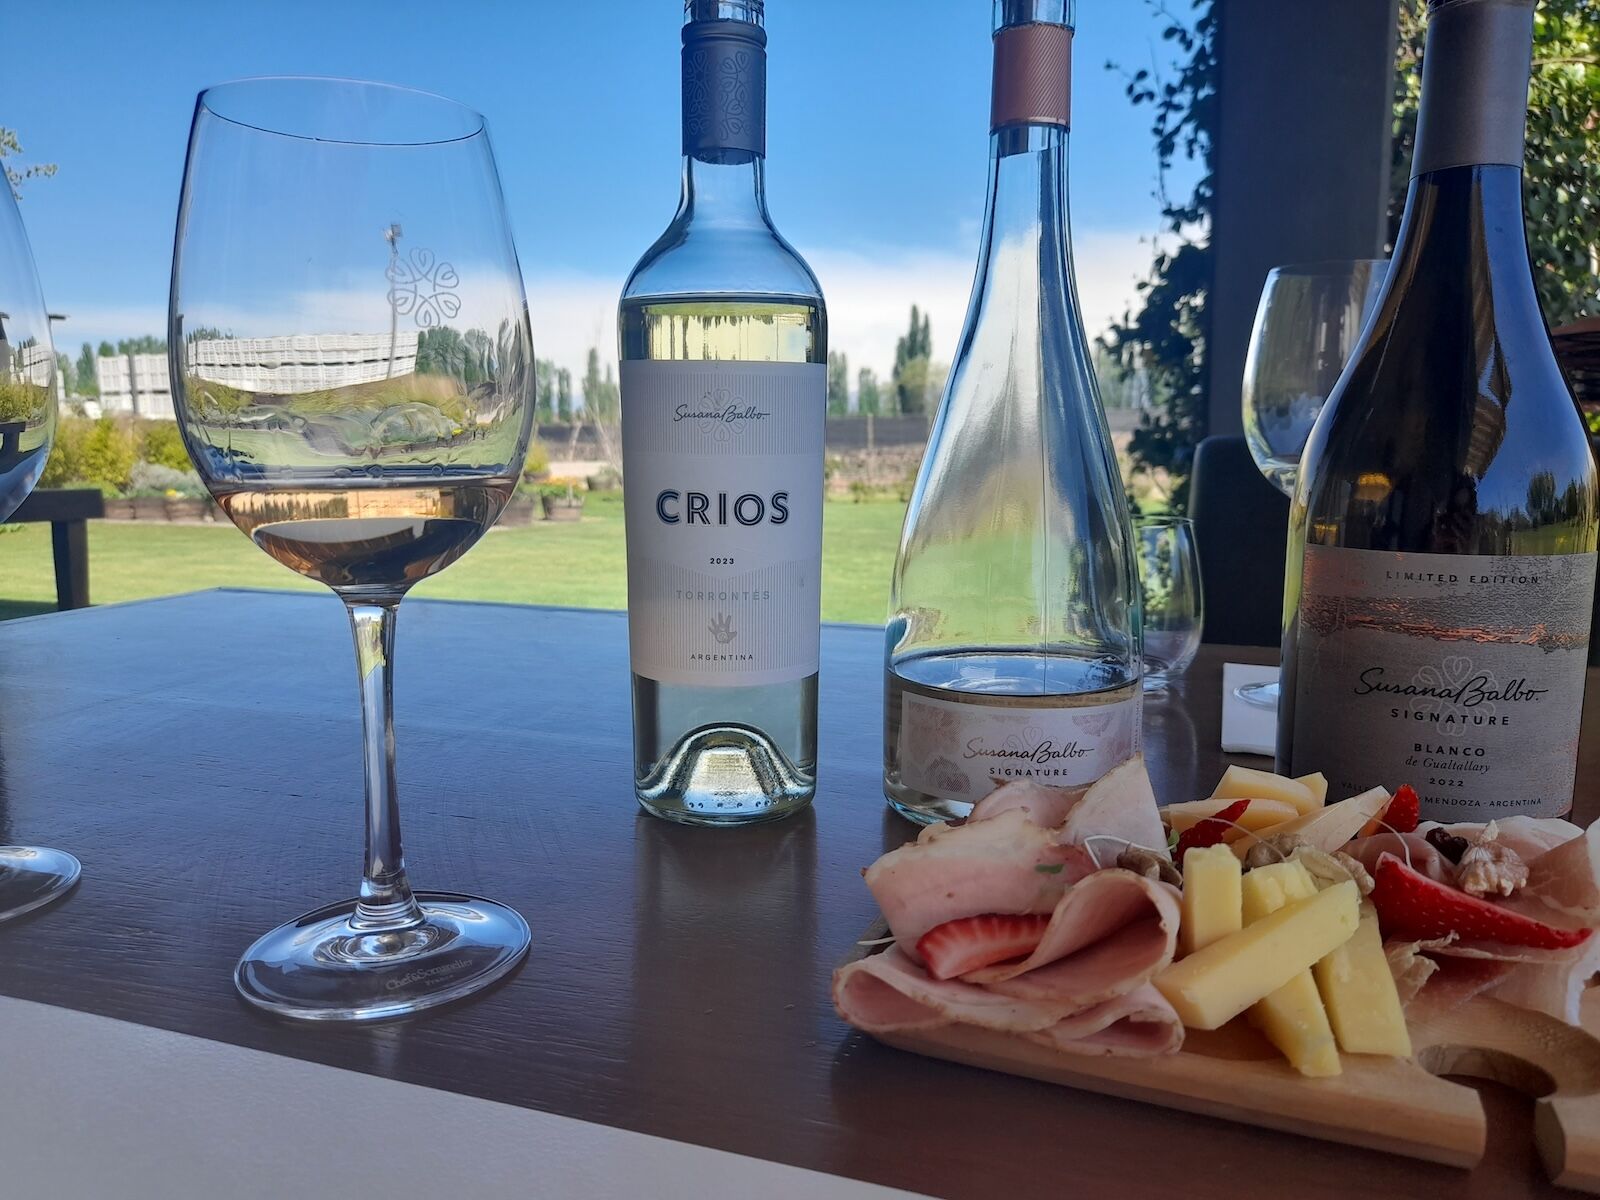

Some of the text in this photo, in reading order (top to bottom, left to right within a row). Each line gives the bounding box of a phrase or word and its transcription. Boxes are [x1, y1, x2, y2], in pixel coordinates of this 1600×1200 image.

[673, 403, 721, 421] Susana
[656, 489, 789, 526] CRIOS
[709, 557, 735, 565] 2023
[1386, 570, 1540, 584] LIMITED EDITION
[690, 653, 754, 661] ARGENTINA
[1354, 667, 1456, 697] Susana
[1391, 708, 1509, 725] SIGNATURE
[963, 737, 1031, 759] Susana
[1414, 743, 1485, 757] BLANCO
[989, 767, 1068, 776] SIGNATURE
[1405, 756, 1491, 775] de Gualtallary
[1429, 777, 1464, 787] 2022
[1424, 796, 1481, 807] MENDOZA
[1489, 799, 1542, 808] ARGENTINA
